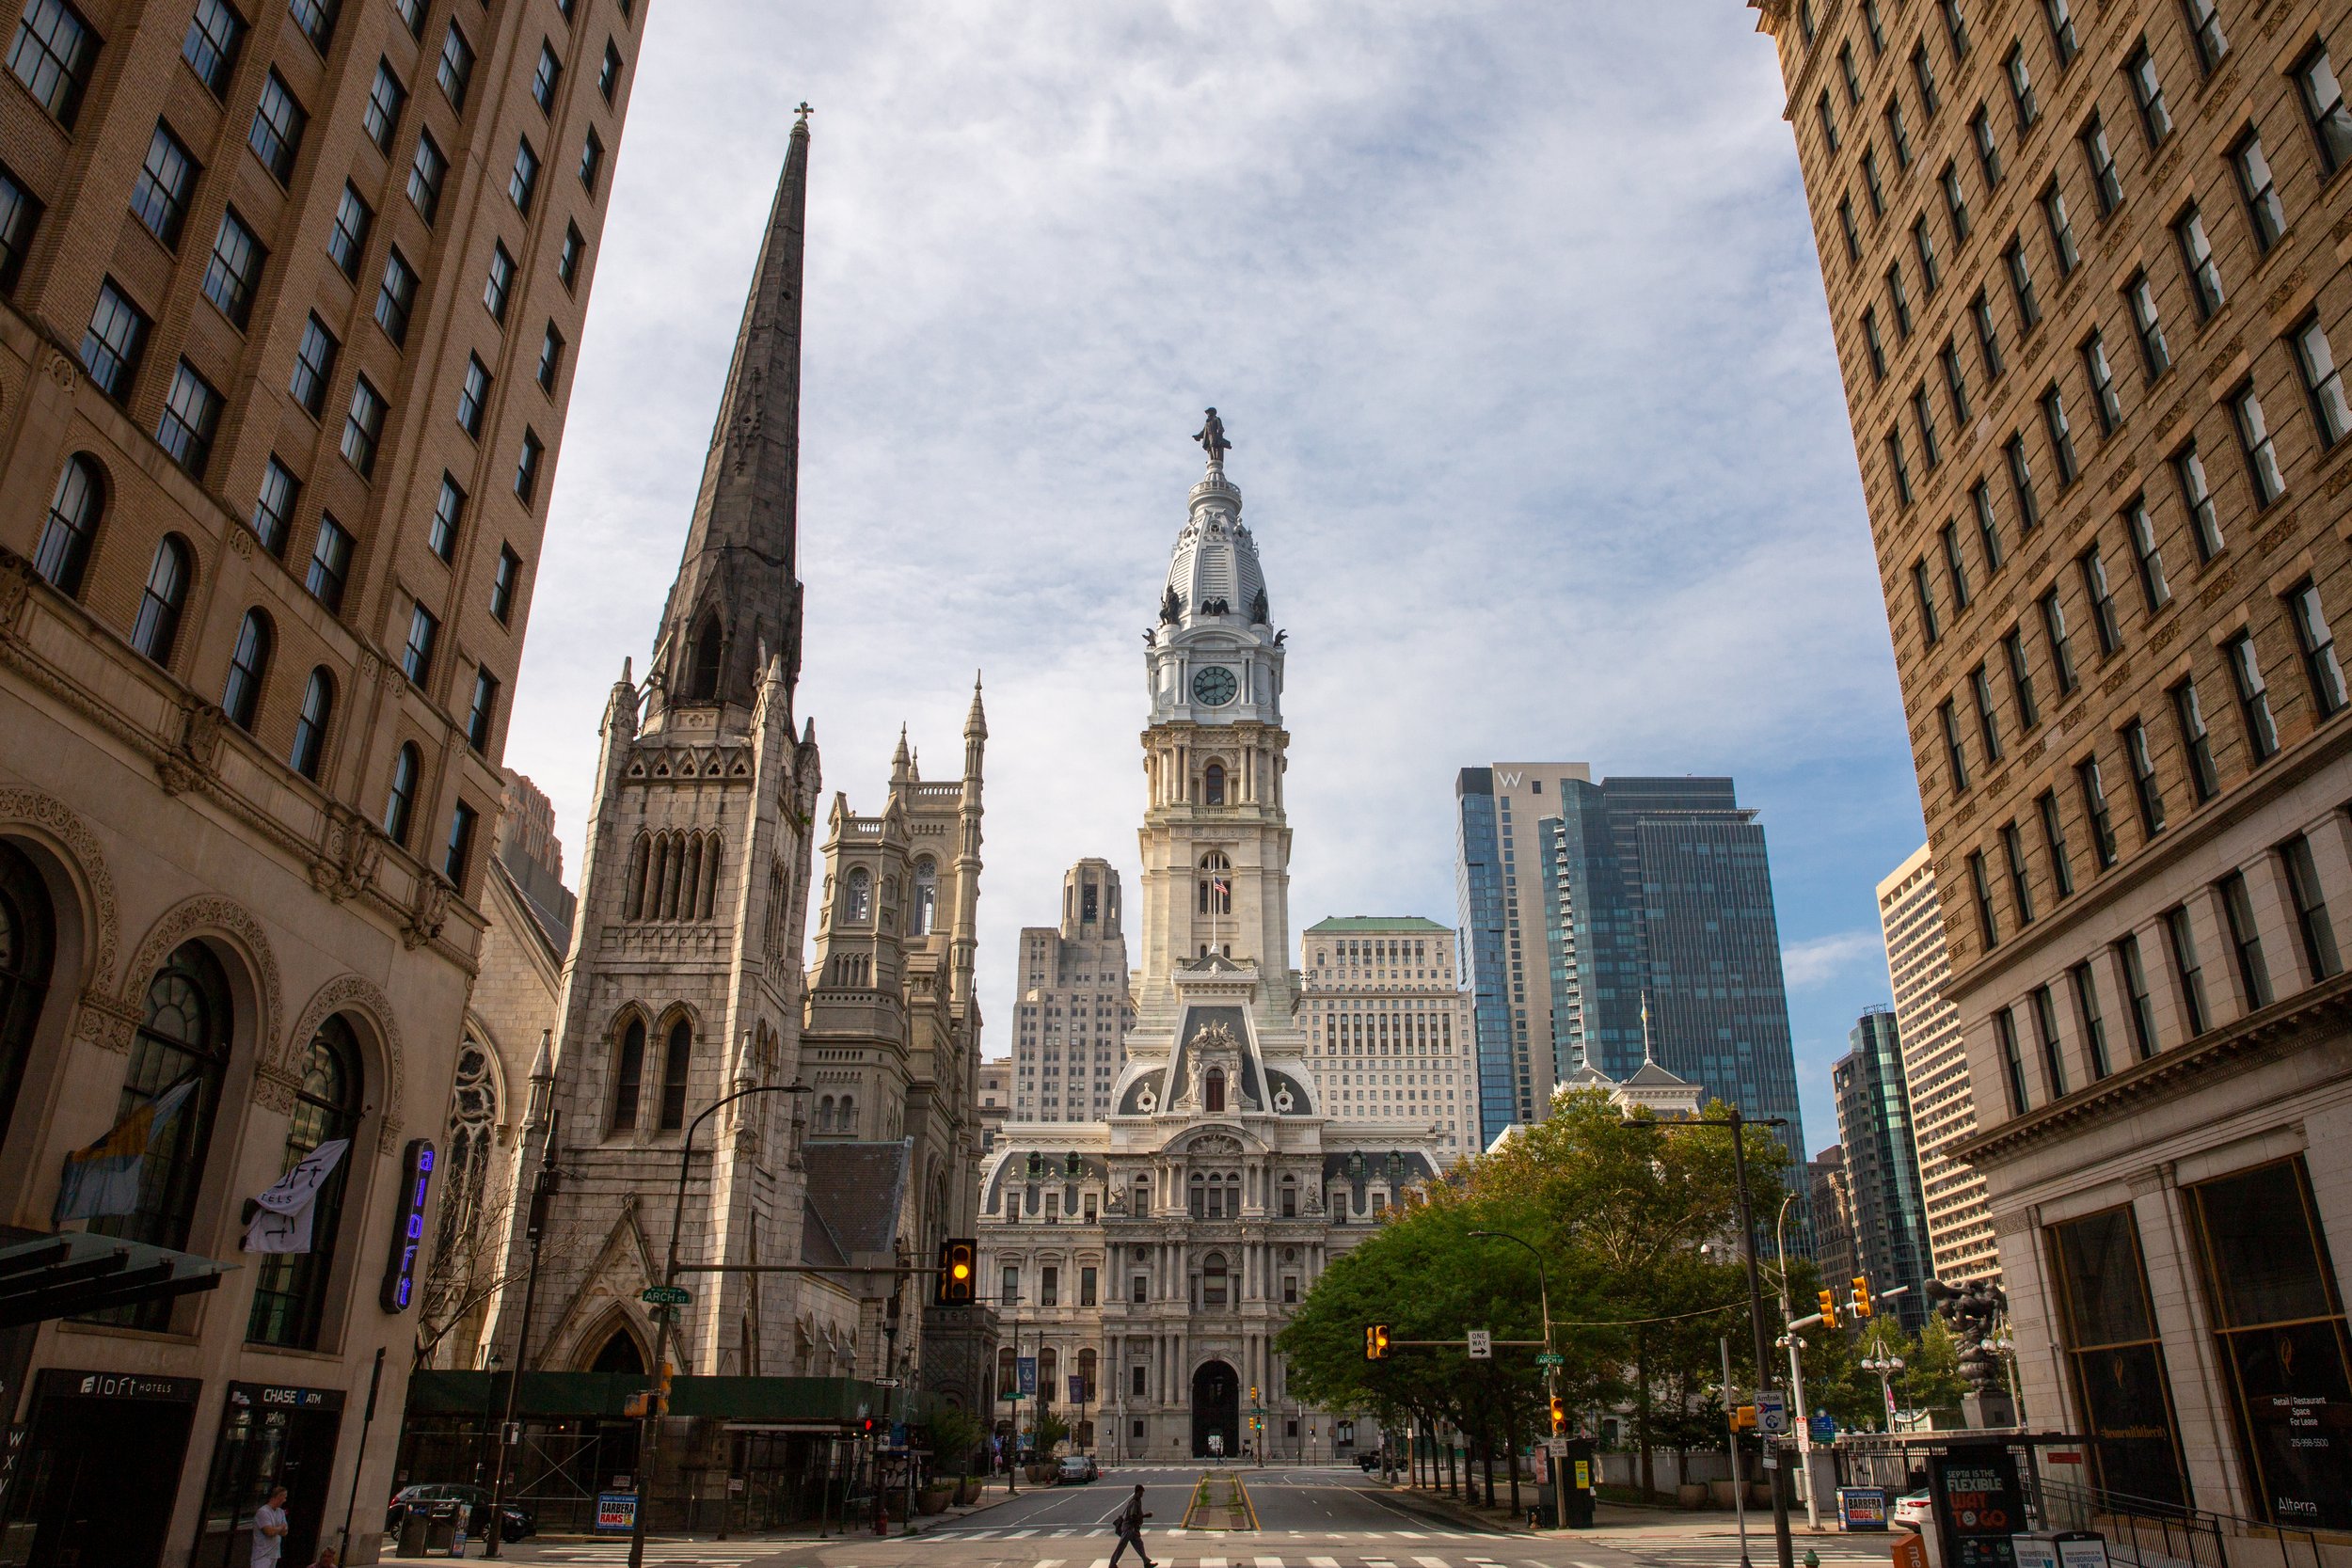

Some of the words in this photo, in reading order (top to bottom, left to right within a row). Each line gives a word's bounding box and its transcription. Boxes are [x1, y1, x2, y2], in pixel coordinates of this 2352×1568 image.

[397, 1150, 434, 1306] aloft
[644, 1291, 675, 1302] ARCH
[80, 1375, 136, 1395] aloft
[139, 1383, 172, 1393] HOTELS
[263, 1388, 297, 1404] CHASE
[305, 1393, 322, 1404] ATM
[2272, 1397, 2290, 1406] Retail
[2293, 1396, 2327, 1405] Restaurant
[2292, 1407, 2311, 1418] Space
[2289, 1418, 2300, 1426] For
[2300, 1418, 2318, 1426] Lease
[1947, 1470, 1970, 1479] SEPTA
[1947, 1478, 2004, 1493] FLEXIBLE
[1848, 1498, 1882, 1509] BARBERA
[1948, 1491, 1988, 1509] WAY
[2279, 1497, 2317, 1513] Alterra
[600, 1502, 634, 1514] BARBERA
[599, 1513, 623, 1523] RAMS
[1850, 1509, 1872, 1519] DODGE
[1979, 1509, 2008, 1528] GO
